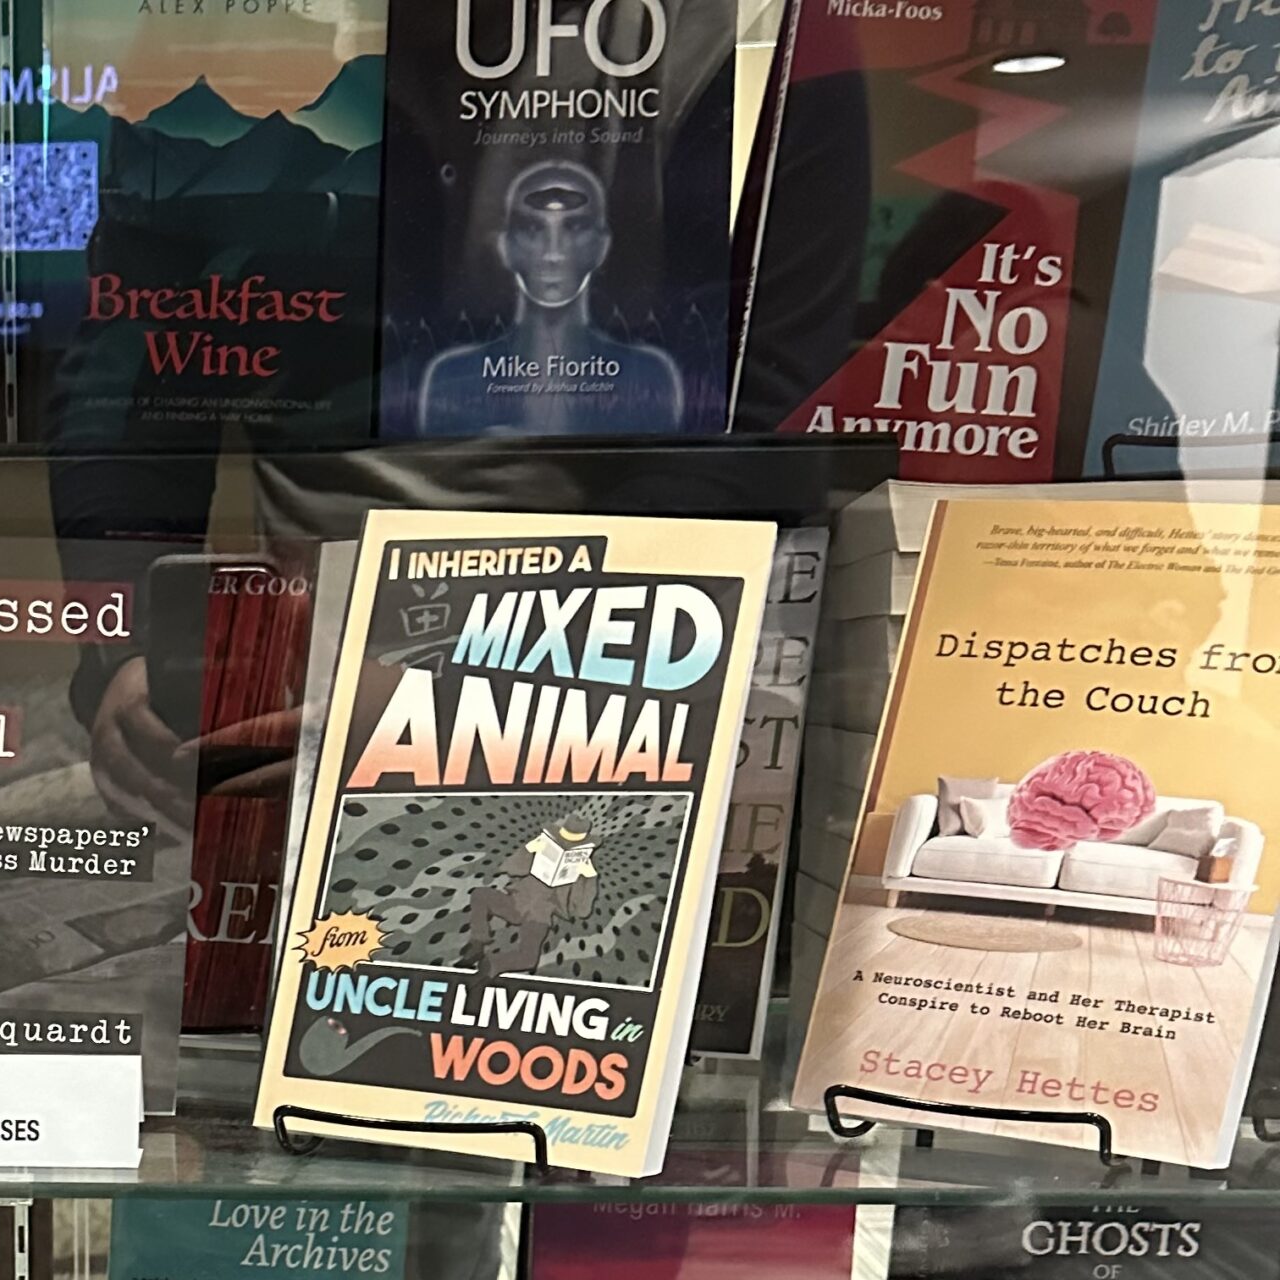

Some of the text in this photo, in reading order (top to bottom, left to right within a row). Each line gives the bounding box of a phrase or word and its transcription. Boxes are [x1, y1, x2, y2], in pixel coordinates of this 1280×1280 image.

[459, 87, 660, 121] SYMPHONIC
[474, 124, 644, 148] Journeys into Sound
[977, 243, 1064, 288] It's
[86, 273, 347, 325] Breakfast
[936, 287, 1050, 356] No
[144, 330, 281, 379] Wine
[482, 354, 621, 379] Mike Fiorito
[874, 341, 1039, 419] Fun
[388, 544, 593, 581] I INHERITED A
[451, 583, 724, 691] MIXED
[996, 680, 1213, 720] the Couch
[344, 667, 694, 789] ANIMAL
[28, 850, 136, 876] Murder
[310, 929, 368, 958] from
[305, 971, 646, 1044] UNCLE LIVING in
[852, 970, 1217, 1027] A Neuroscientist and Her Therapist
[877, 991, 1177, 1041] Conspire to Reboot Her Brain
[429, 1031, 629, 1102] WOODS
[859, 1048, 1160, 1114] Stacey Hettes
[240, 1232, 393, 1273] Archives
[1022, 1220, 1201, 1258] GHOSTS
[1092, 1263, 1122, 1280] OF
